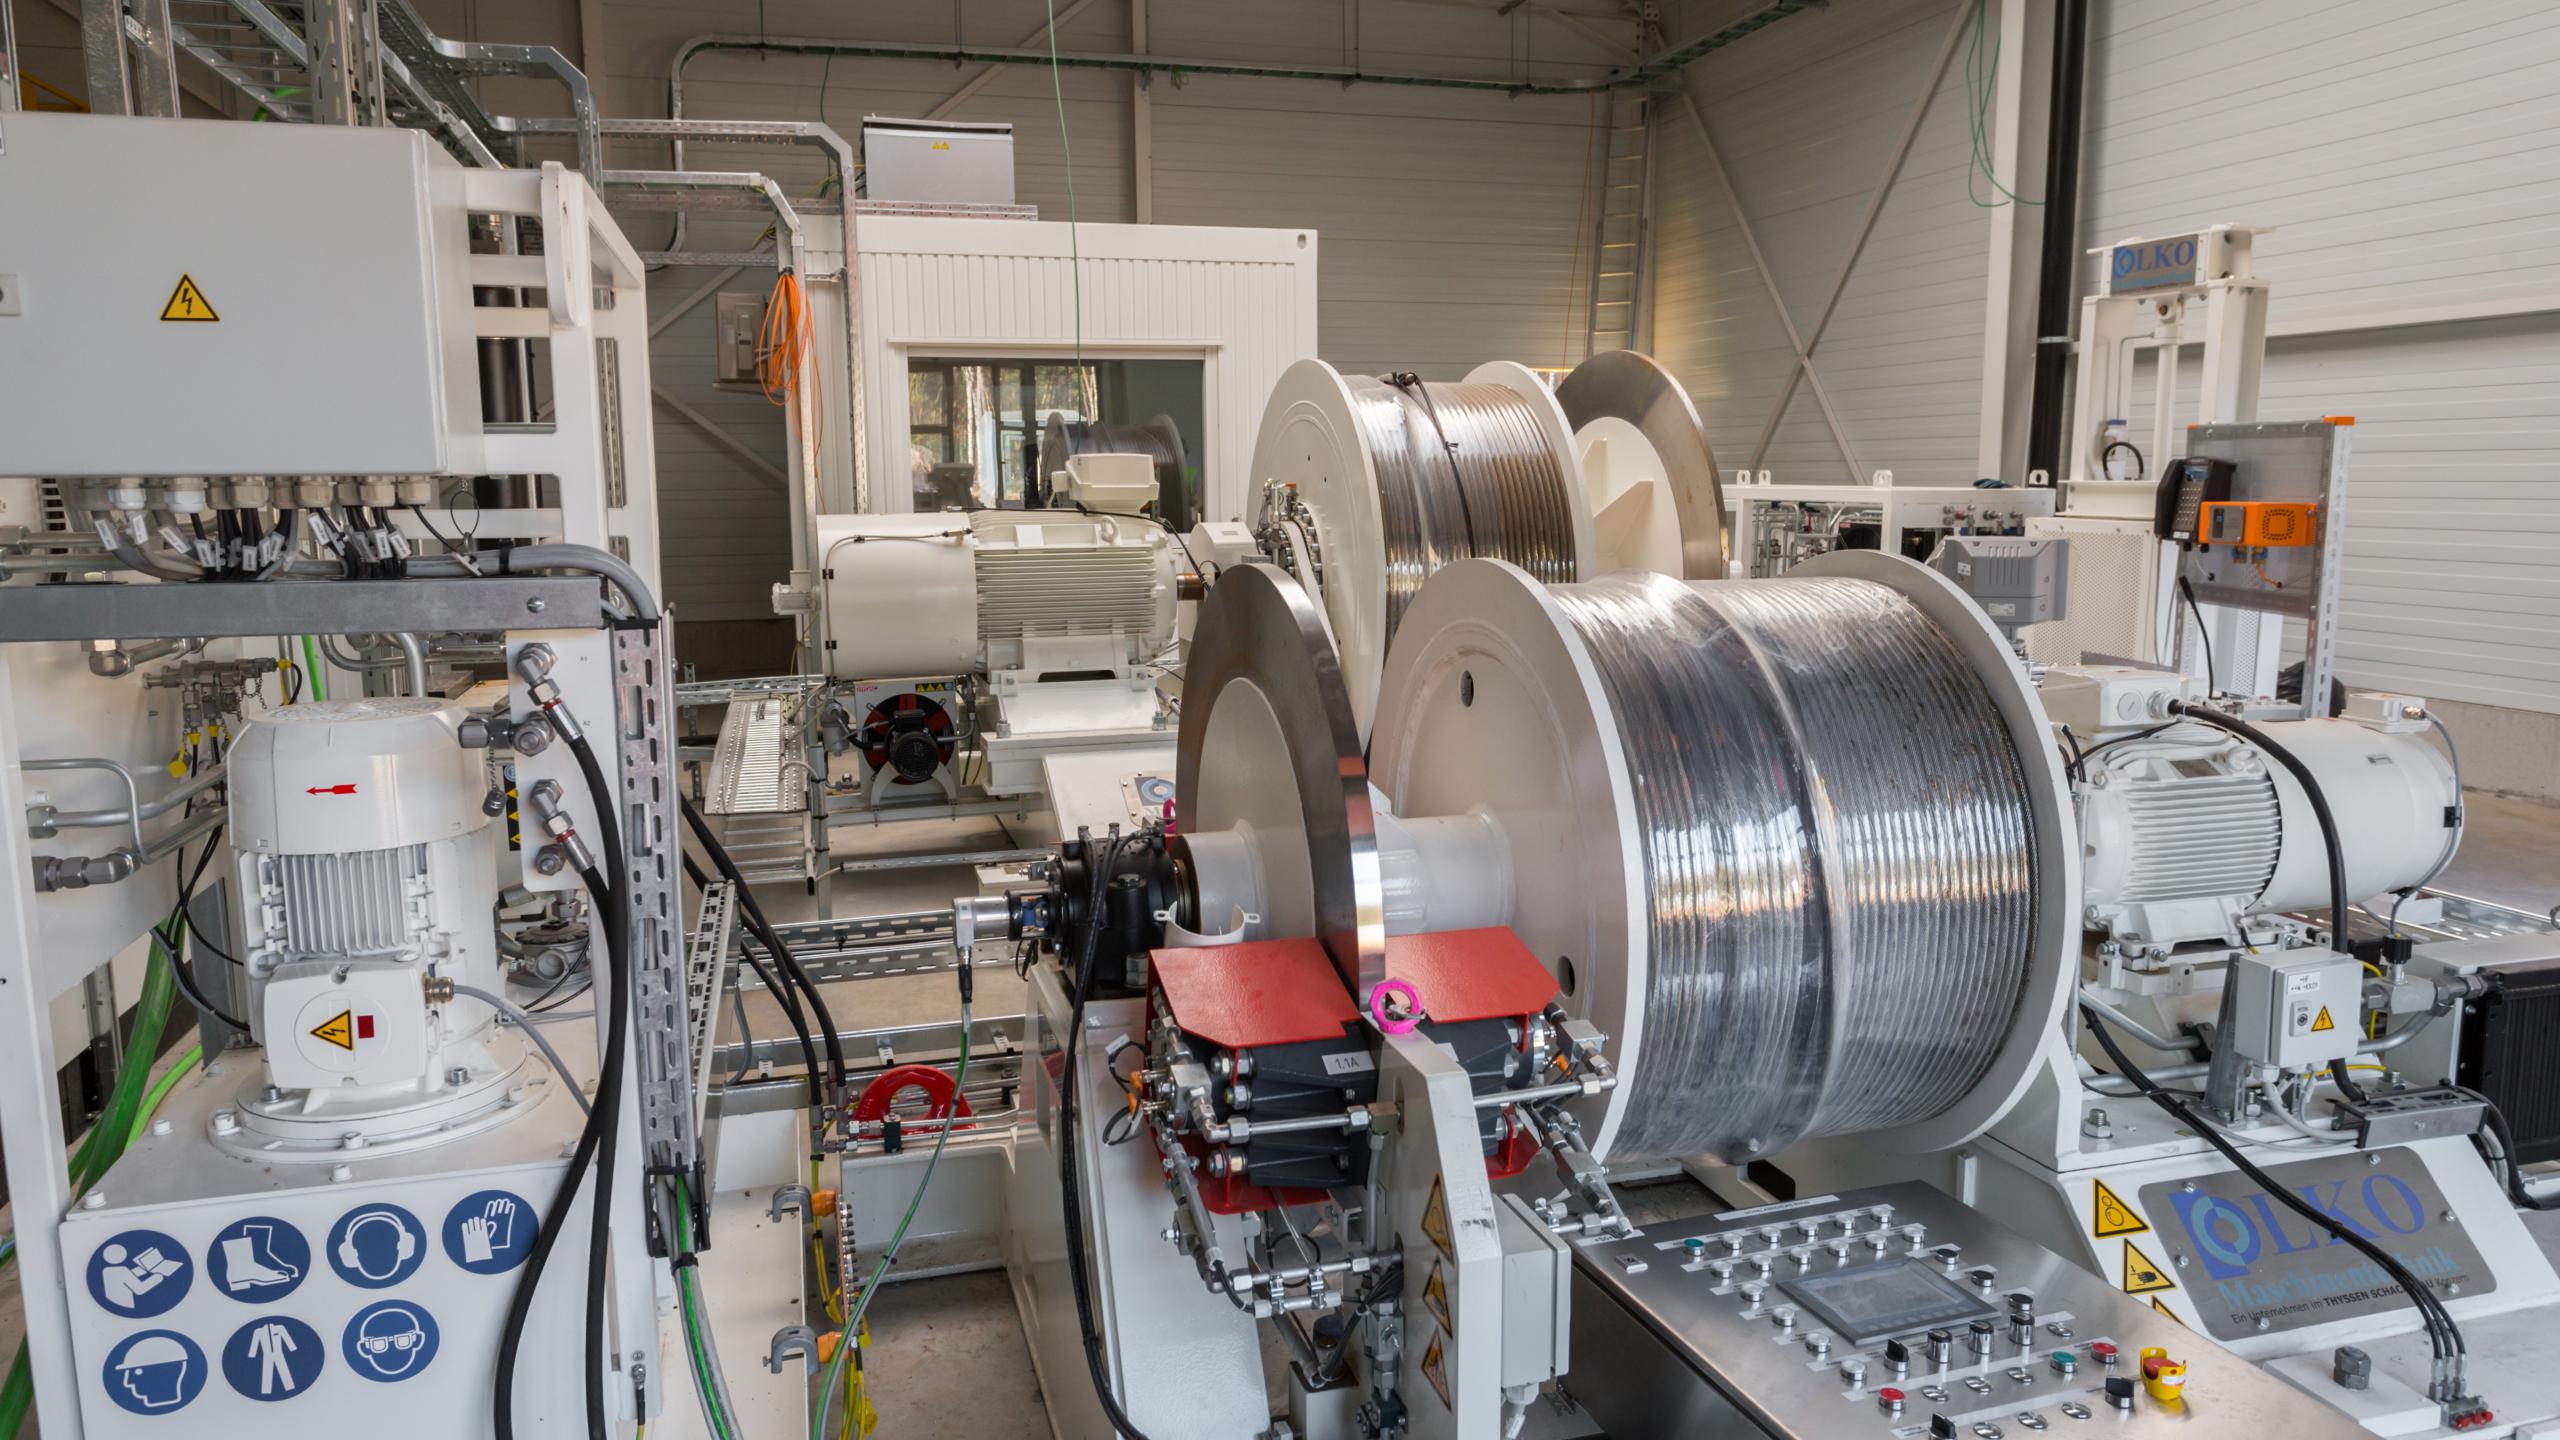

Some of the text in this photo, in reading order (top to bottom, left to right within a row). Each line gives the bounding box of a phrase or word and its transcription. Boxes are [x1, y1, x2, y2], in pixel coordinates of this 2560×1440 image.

[1335, 1057, 1359, 1070] 1.1A
[2216, 1247, 2462, 1311] Maschinentehnik
[2231, 1312, 2248, 1325] Ein
[2248, 1301, 2310, 1321] Unternehmen
[2311, 1300, 2324, 1311] im
[2323, 1289, 2369, 1307] THYSSEN
